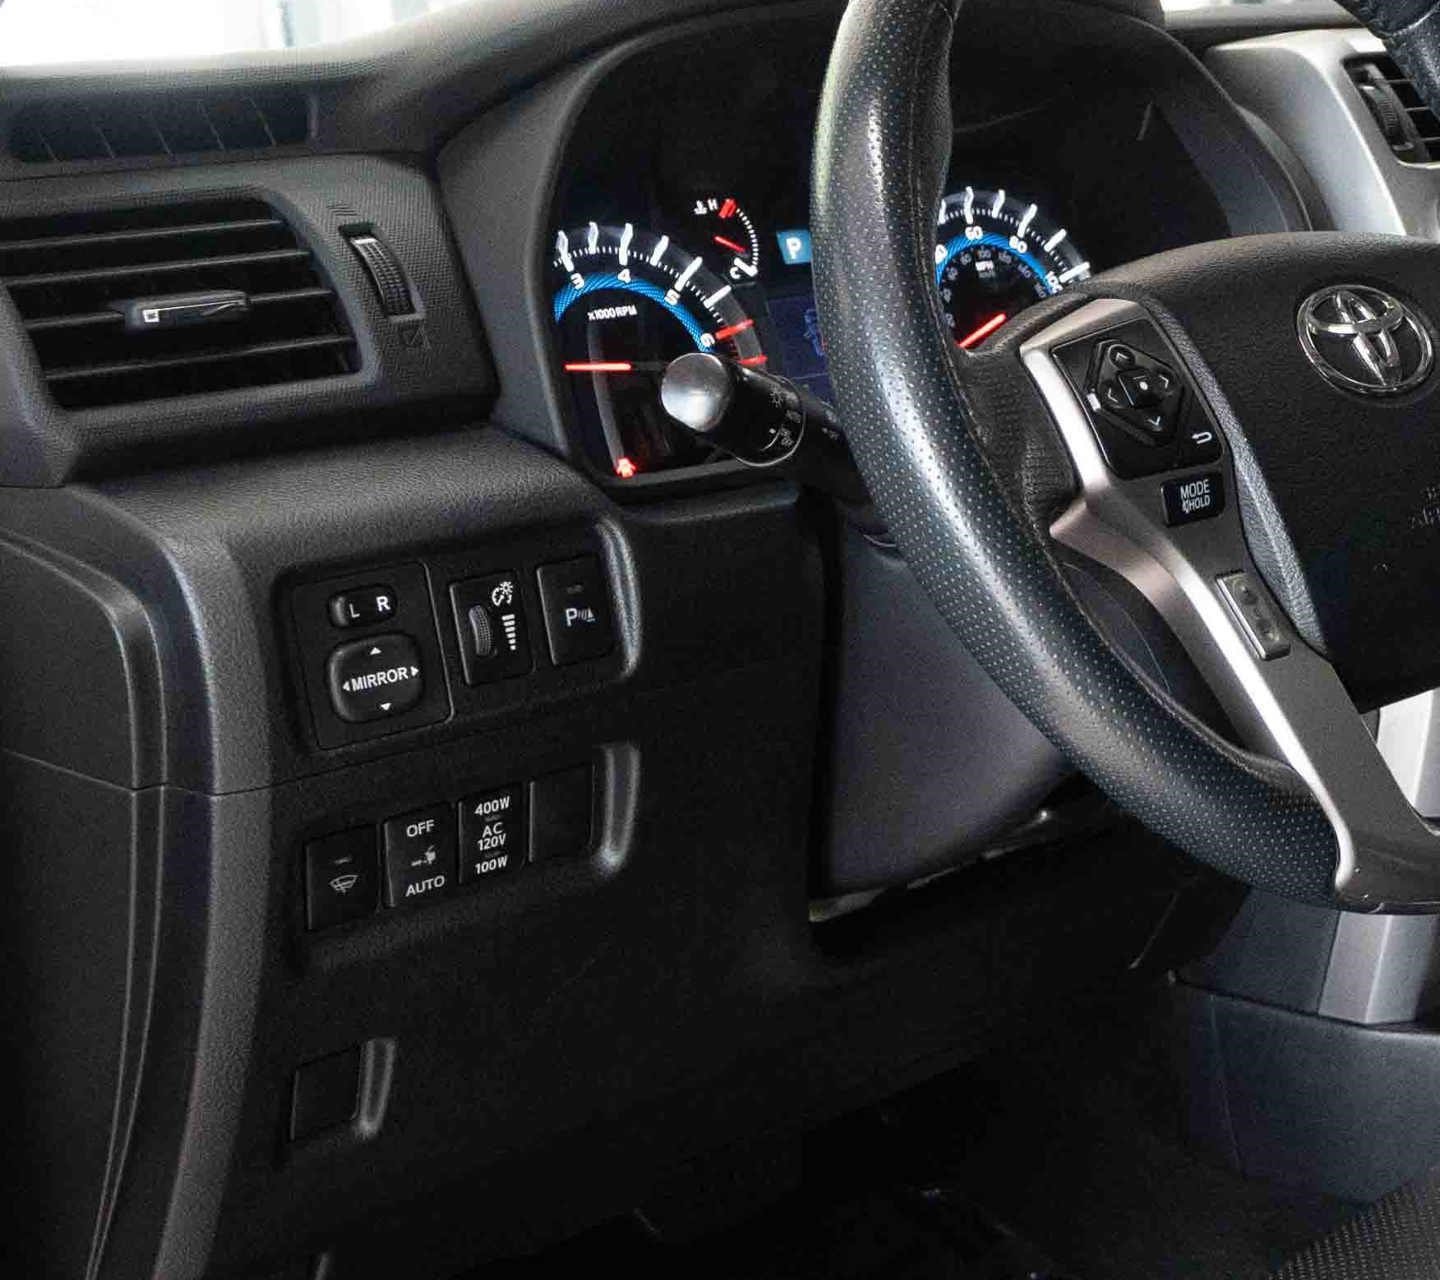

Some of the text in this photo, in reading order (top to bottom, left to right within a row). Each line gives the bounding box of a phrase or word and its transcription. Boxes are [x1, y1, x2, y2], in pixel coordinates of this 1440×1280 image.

[785, 237, 802, 259] P
[570, 272, 585, 290] 3
[617, 268, 632, 283] 4
[664, 288, 681, 305] 5
[1179, 478, 1210, 499] MODE
[1189, 495, 1211, 511] HOLD
[349, 595, 392, 619] L R
[351, 666, 409, 692] MIRROR
[474, 795, 511, 816] 400W
[406, 819, 435, 838] OFF
[481, 821, 505, 839] AC
[476, 833, 507, 852] 120V
[474, 855, 509, 875] 100W
[405, 875, 446, 897] AUTO
